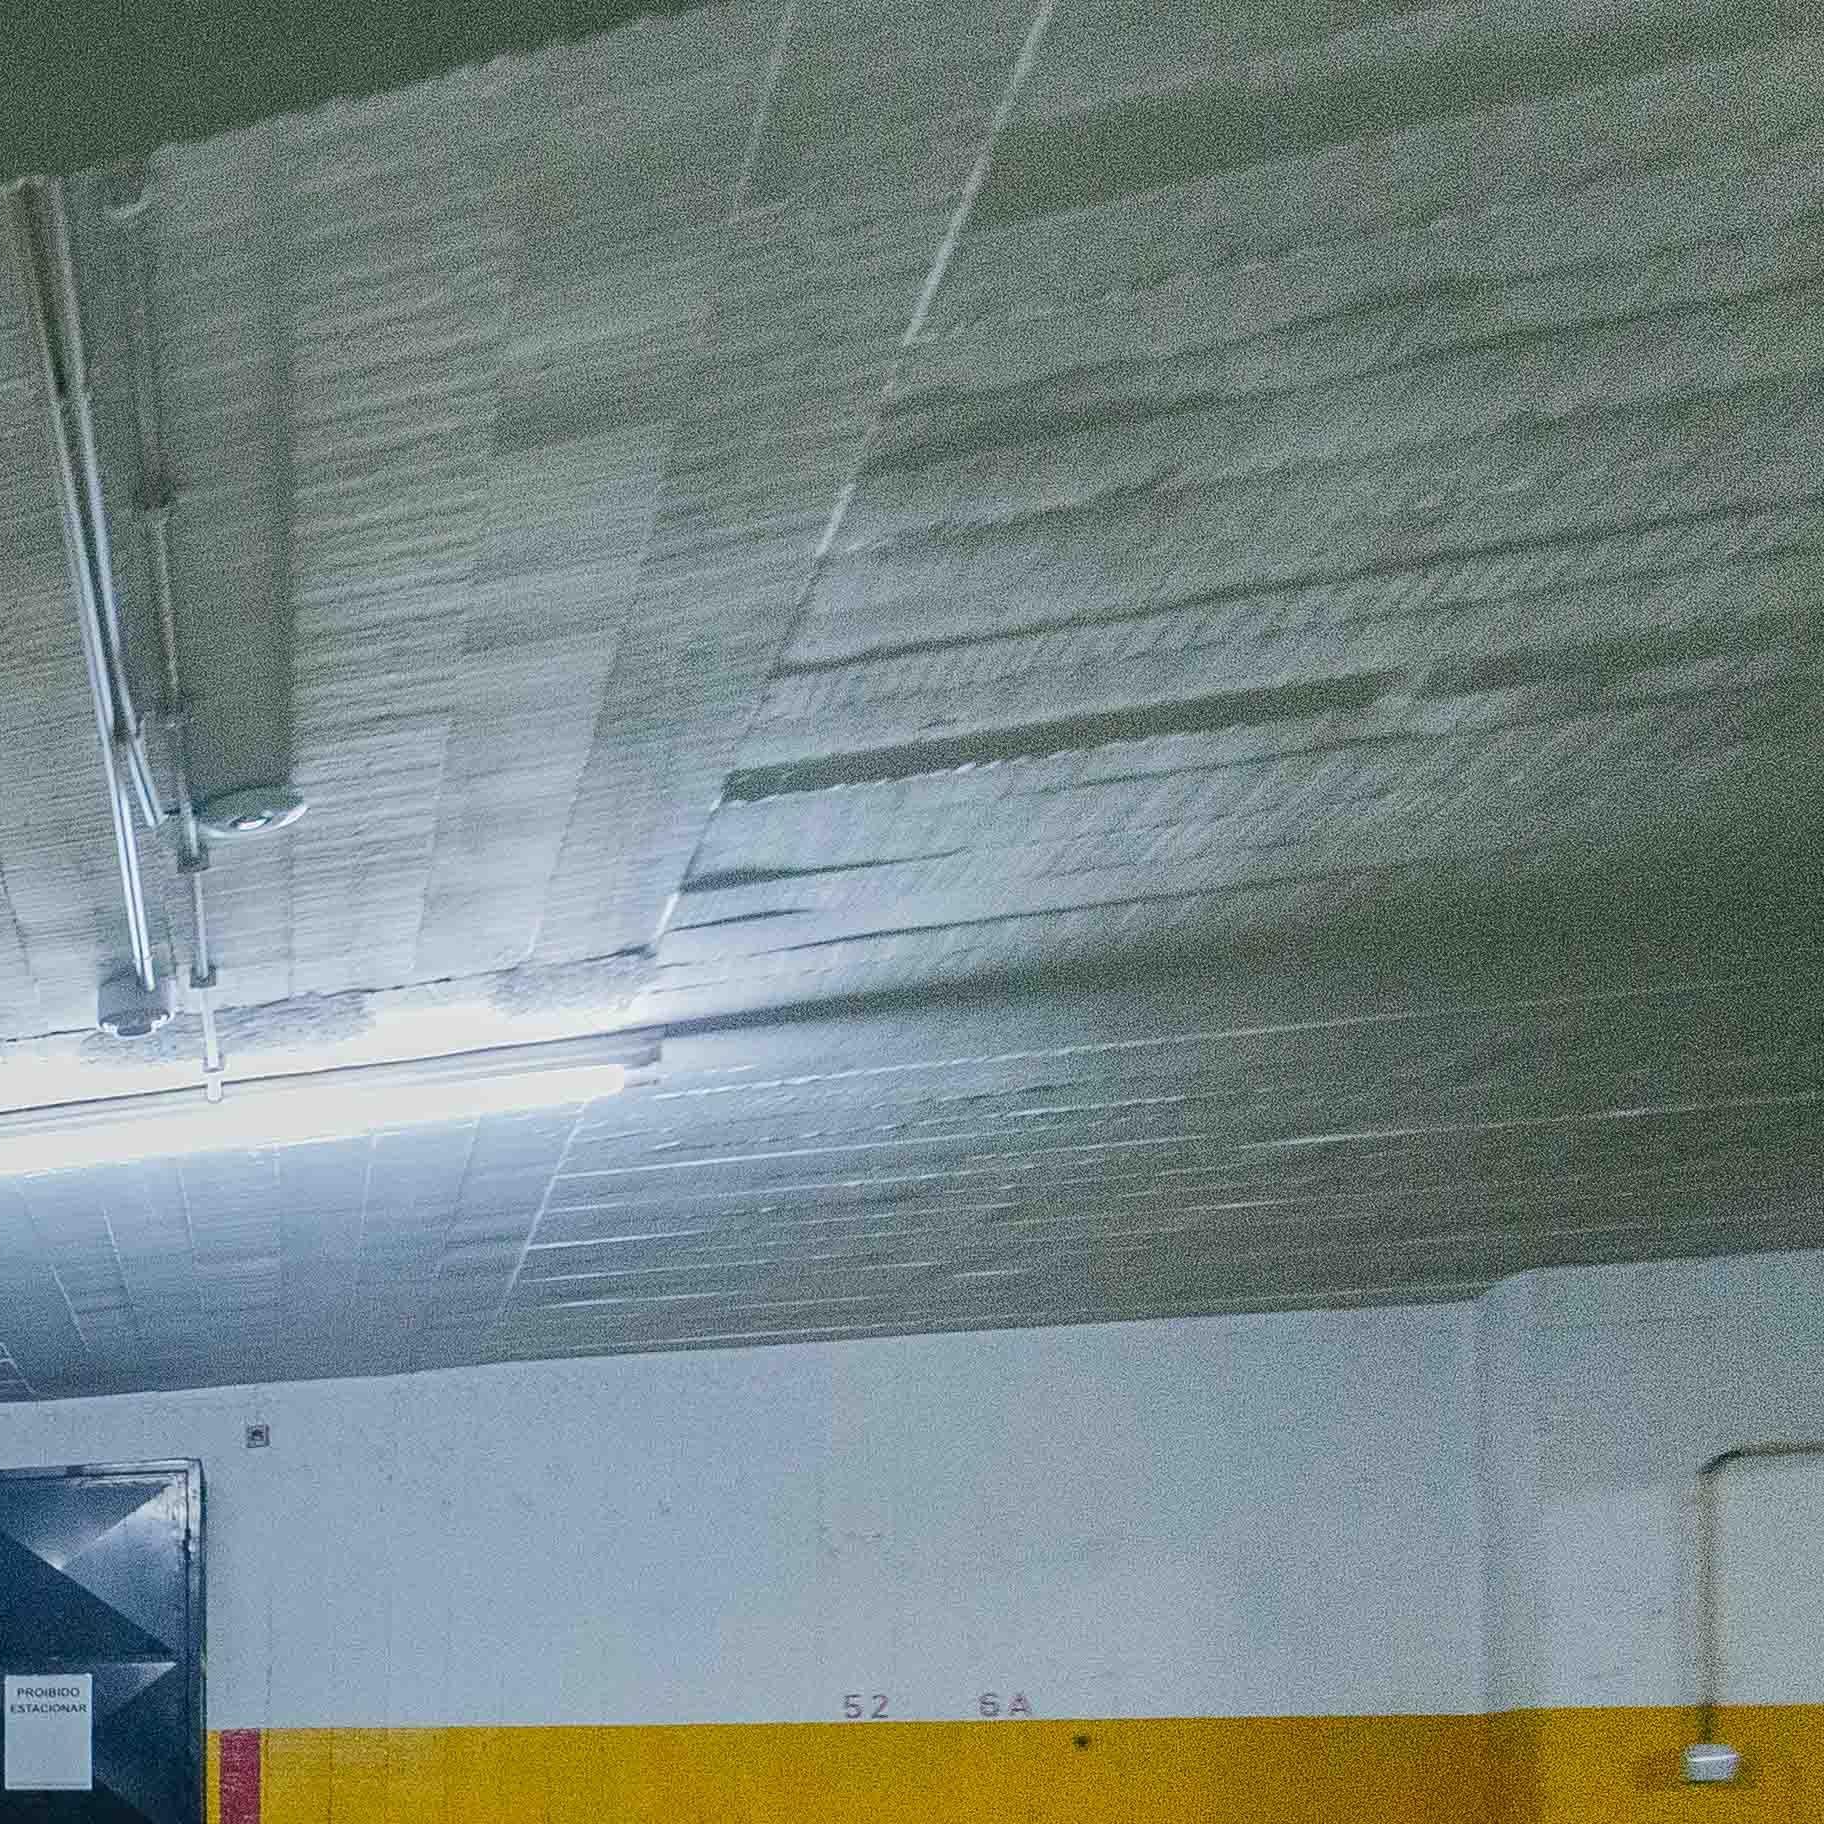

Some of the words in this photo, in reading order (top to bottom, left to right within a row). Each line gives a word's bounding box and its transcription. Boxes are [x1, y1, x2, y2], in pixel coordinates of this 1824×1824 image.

[16, 1687, 81, 1698] PROIBIDO
[10, 1703, 88, 1713] ESTACIONAR
[844, 1693, 889, 1719] 52
